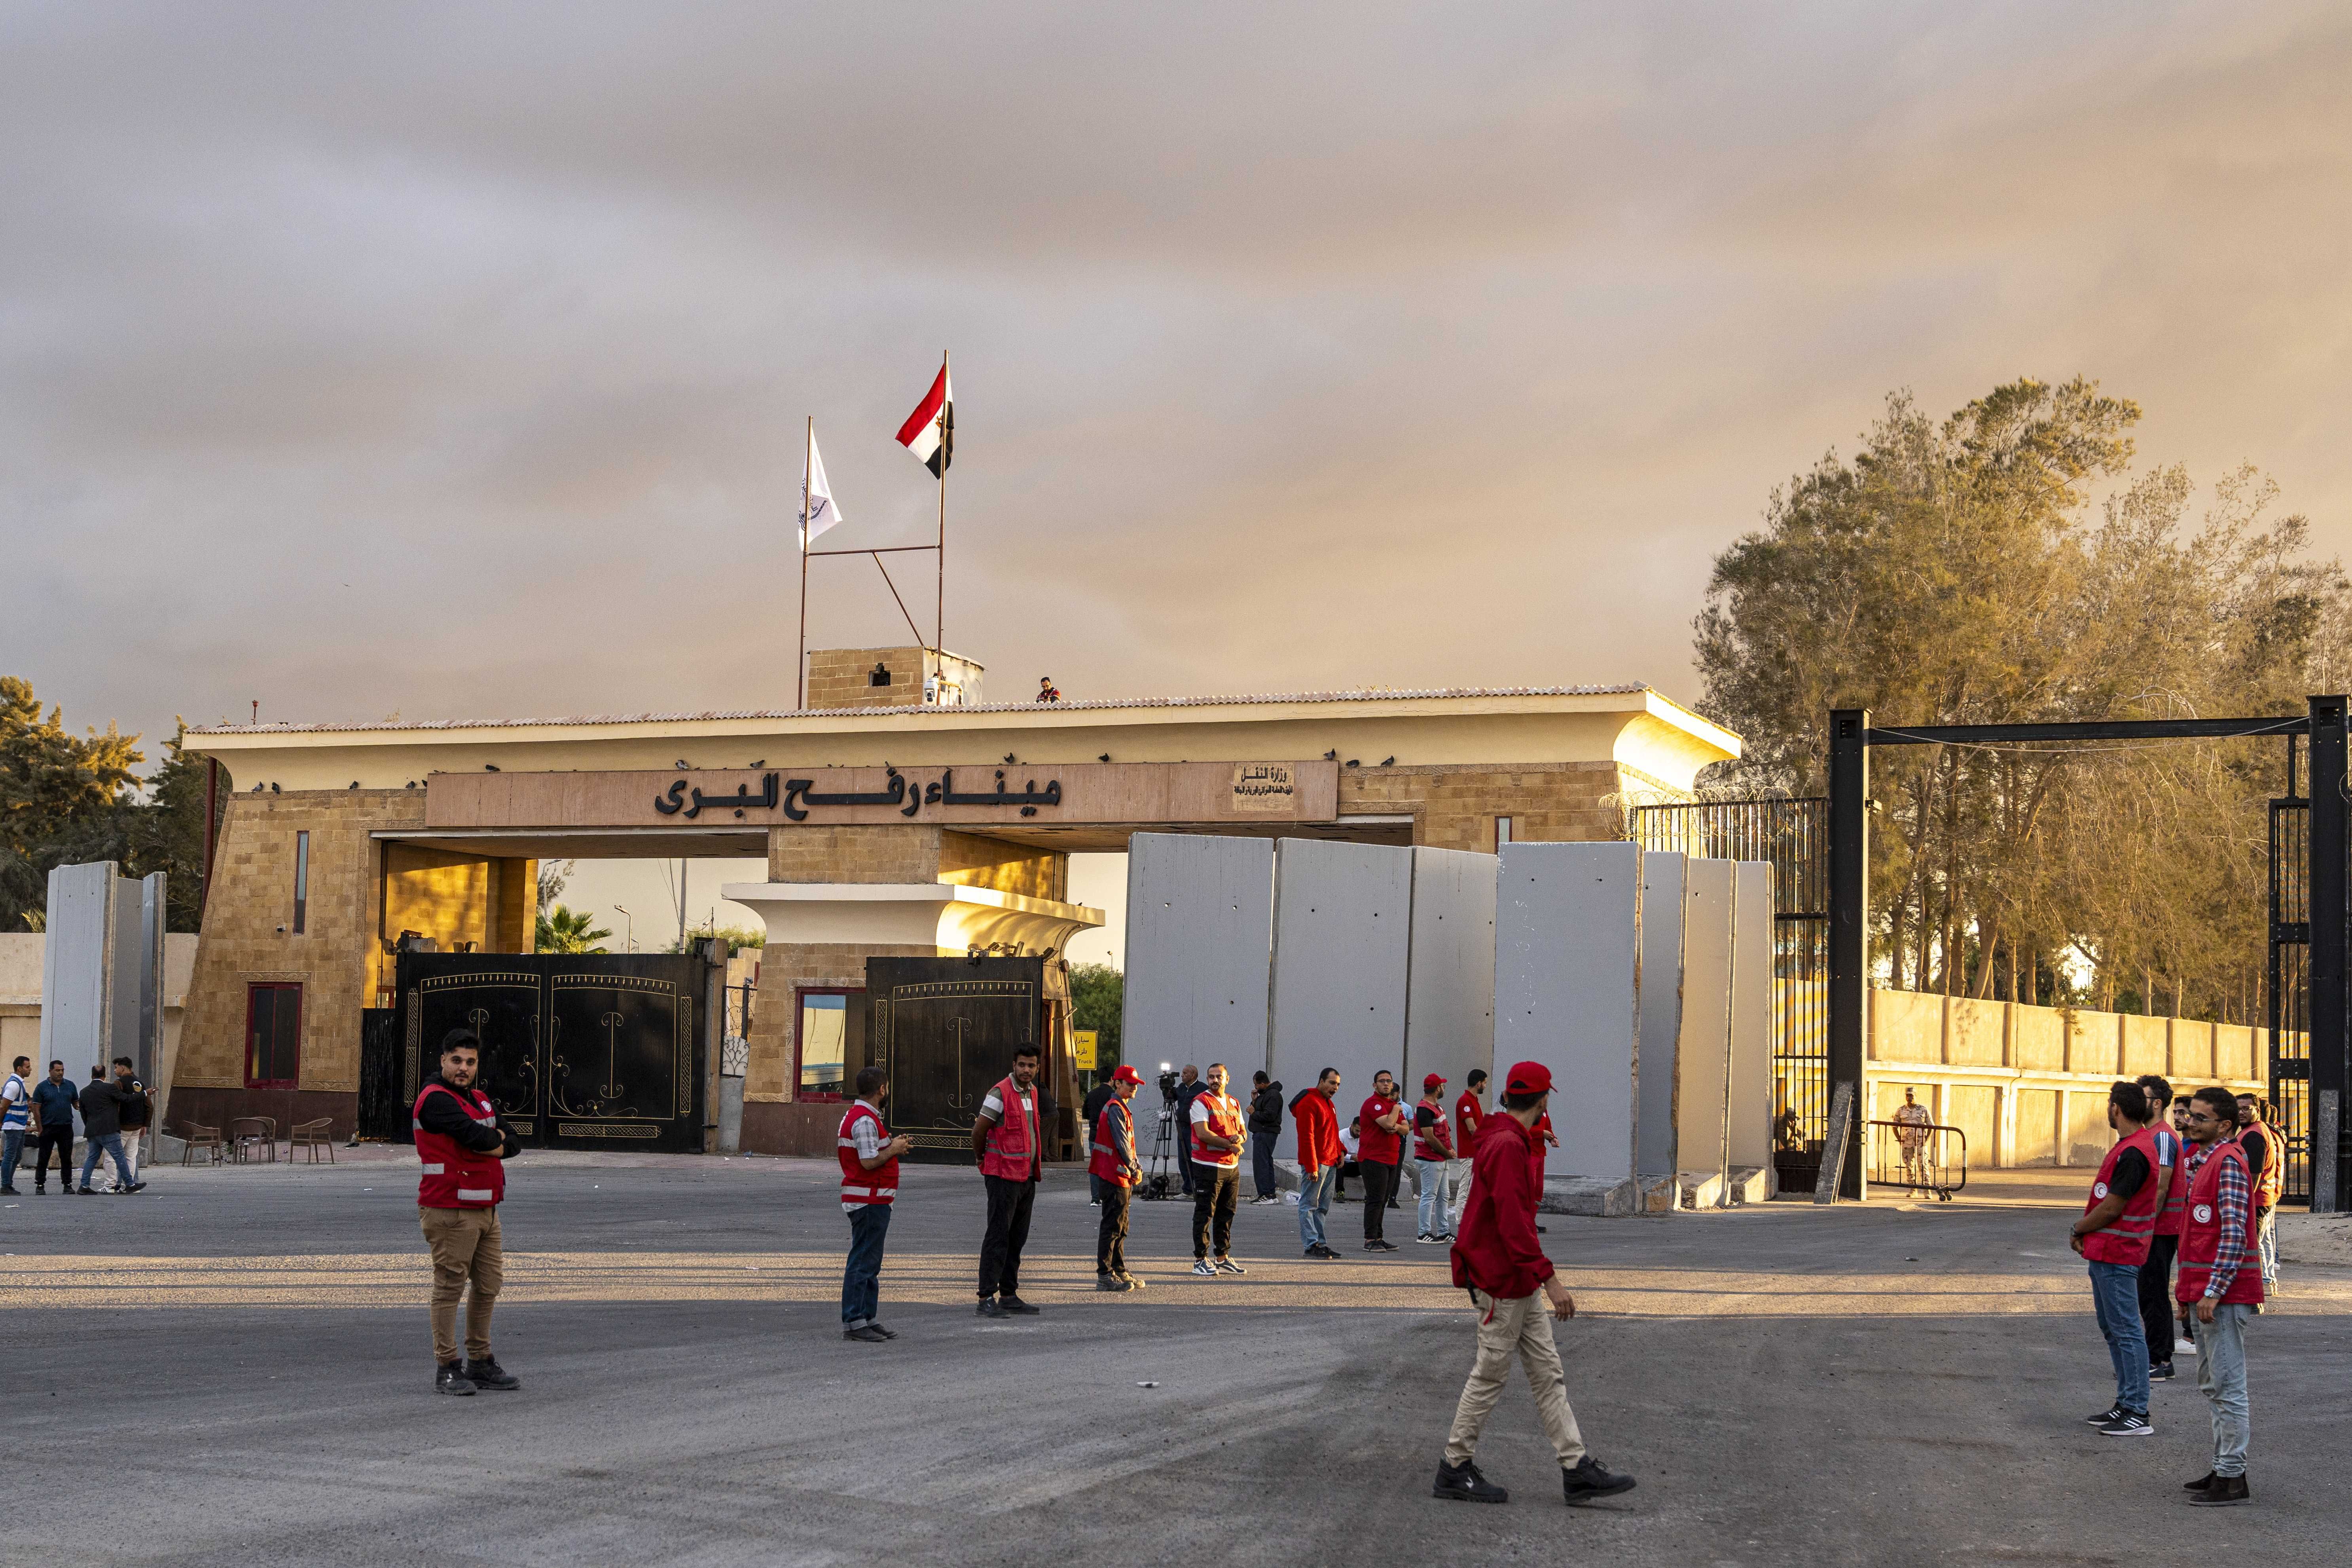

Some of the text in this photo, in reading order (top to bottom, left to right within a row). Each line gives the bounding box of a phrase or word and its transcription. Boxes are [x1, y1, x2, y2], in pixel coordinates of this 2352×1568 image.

[784, 767, 920, 821] رفح
[924, 767, 1061, 817] ميناء
[1241, 766, 1287, 783] وزارة النقل
